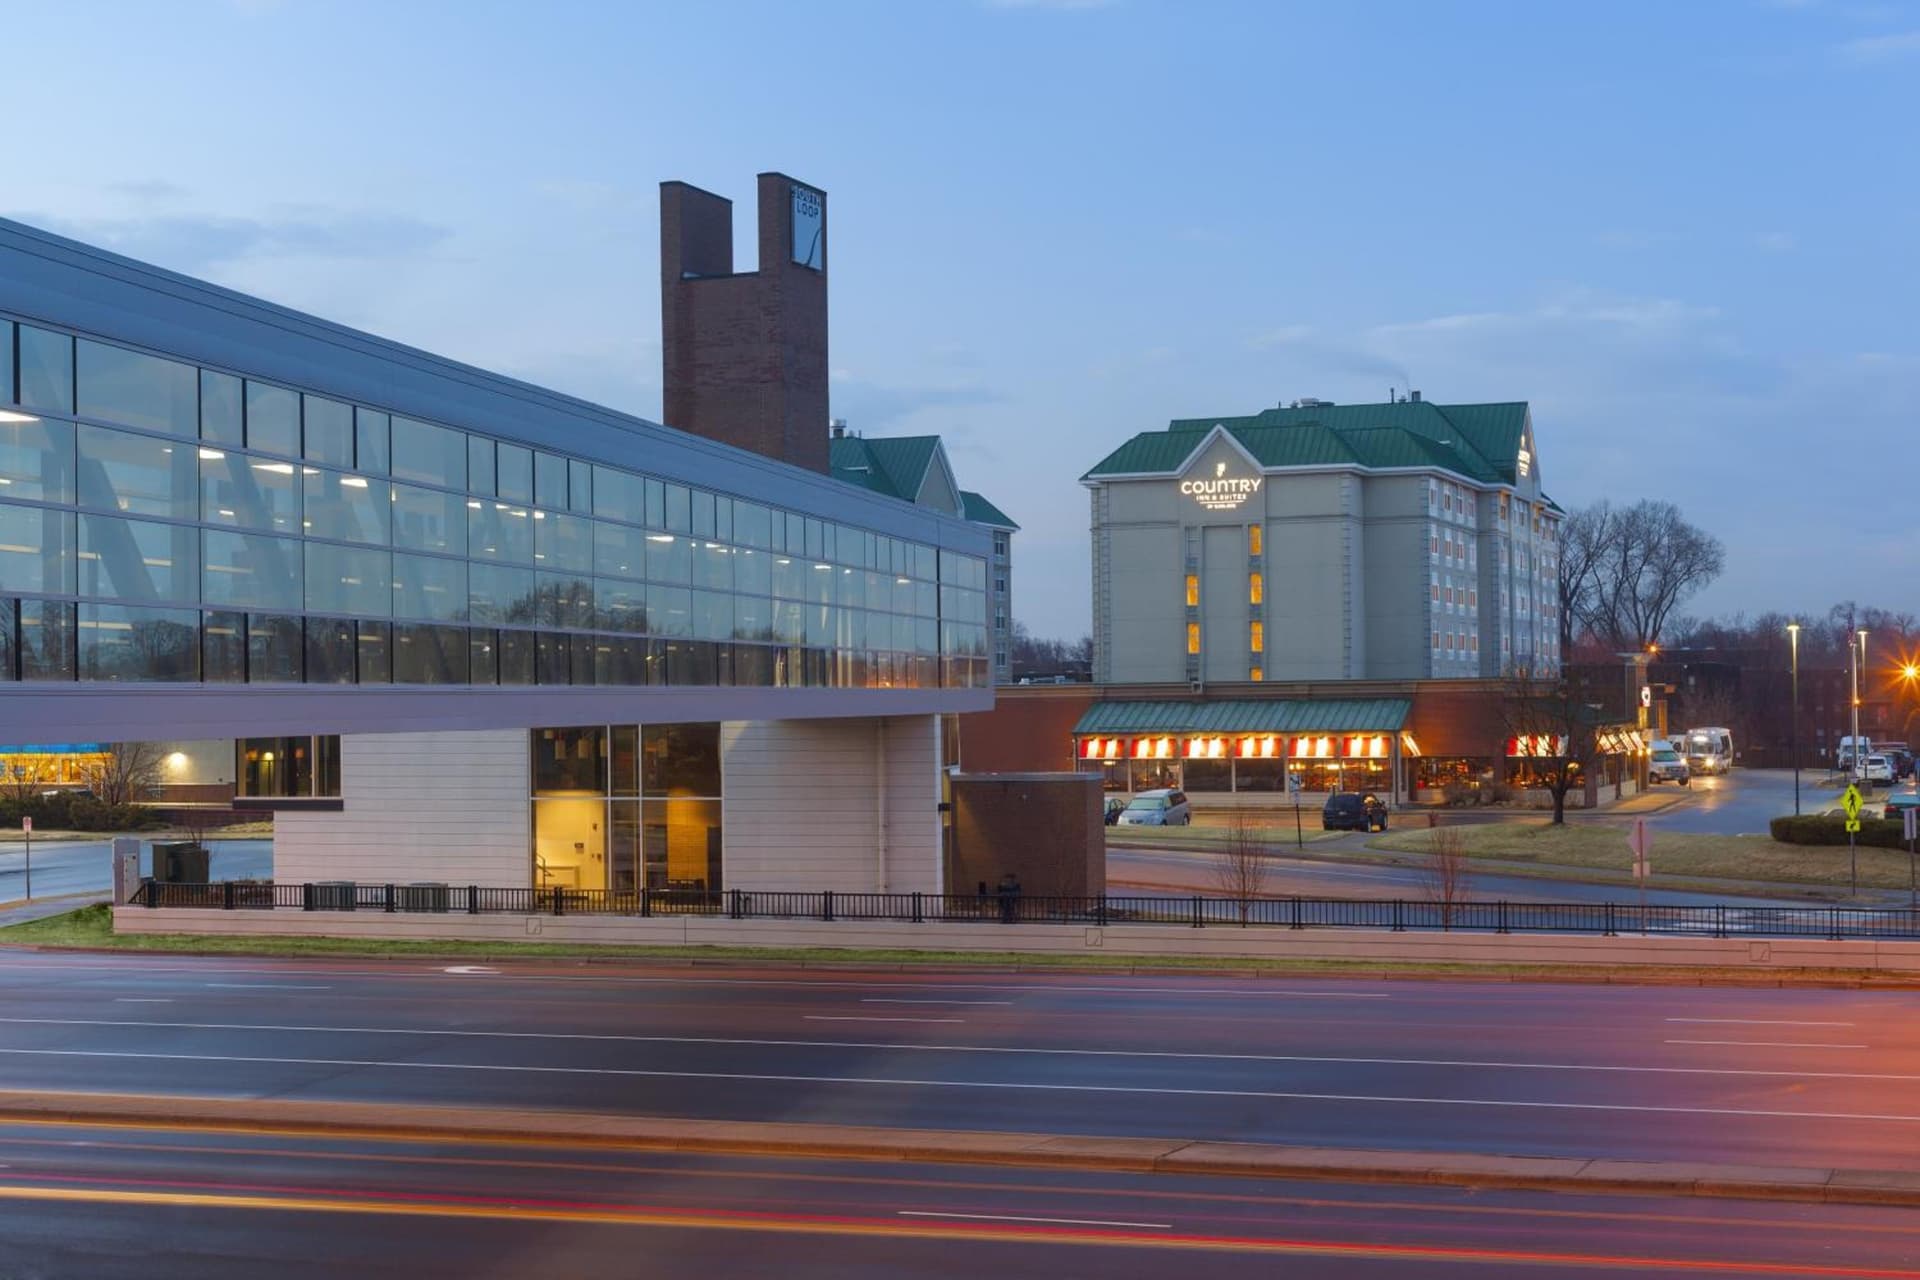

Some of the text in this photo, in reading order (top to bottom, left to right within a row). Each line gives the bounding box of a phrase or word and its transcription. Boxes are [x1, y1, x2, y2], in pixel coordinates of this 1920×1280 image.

[796, 200, 819, 219] LOOP
[1181, 478, 1262, 494] COUNTRY
[1196, 494, 1210, 502] INN
[1219, 493, 1247, 501] SUITES
